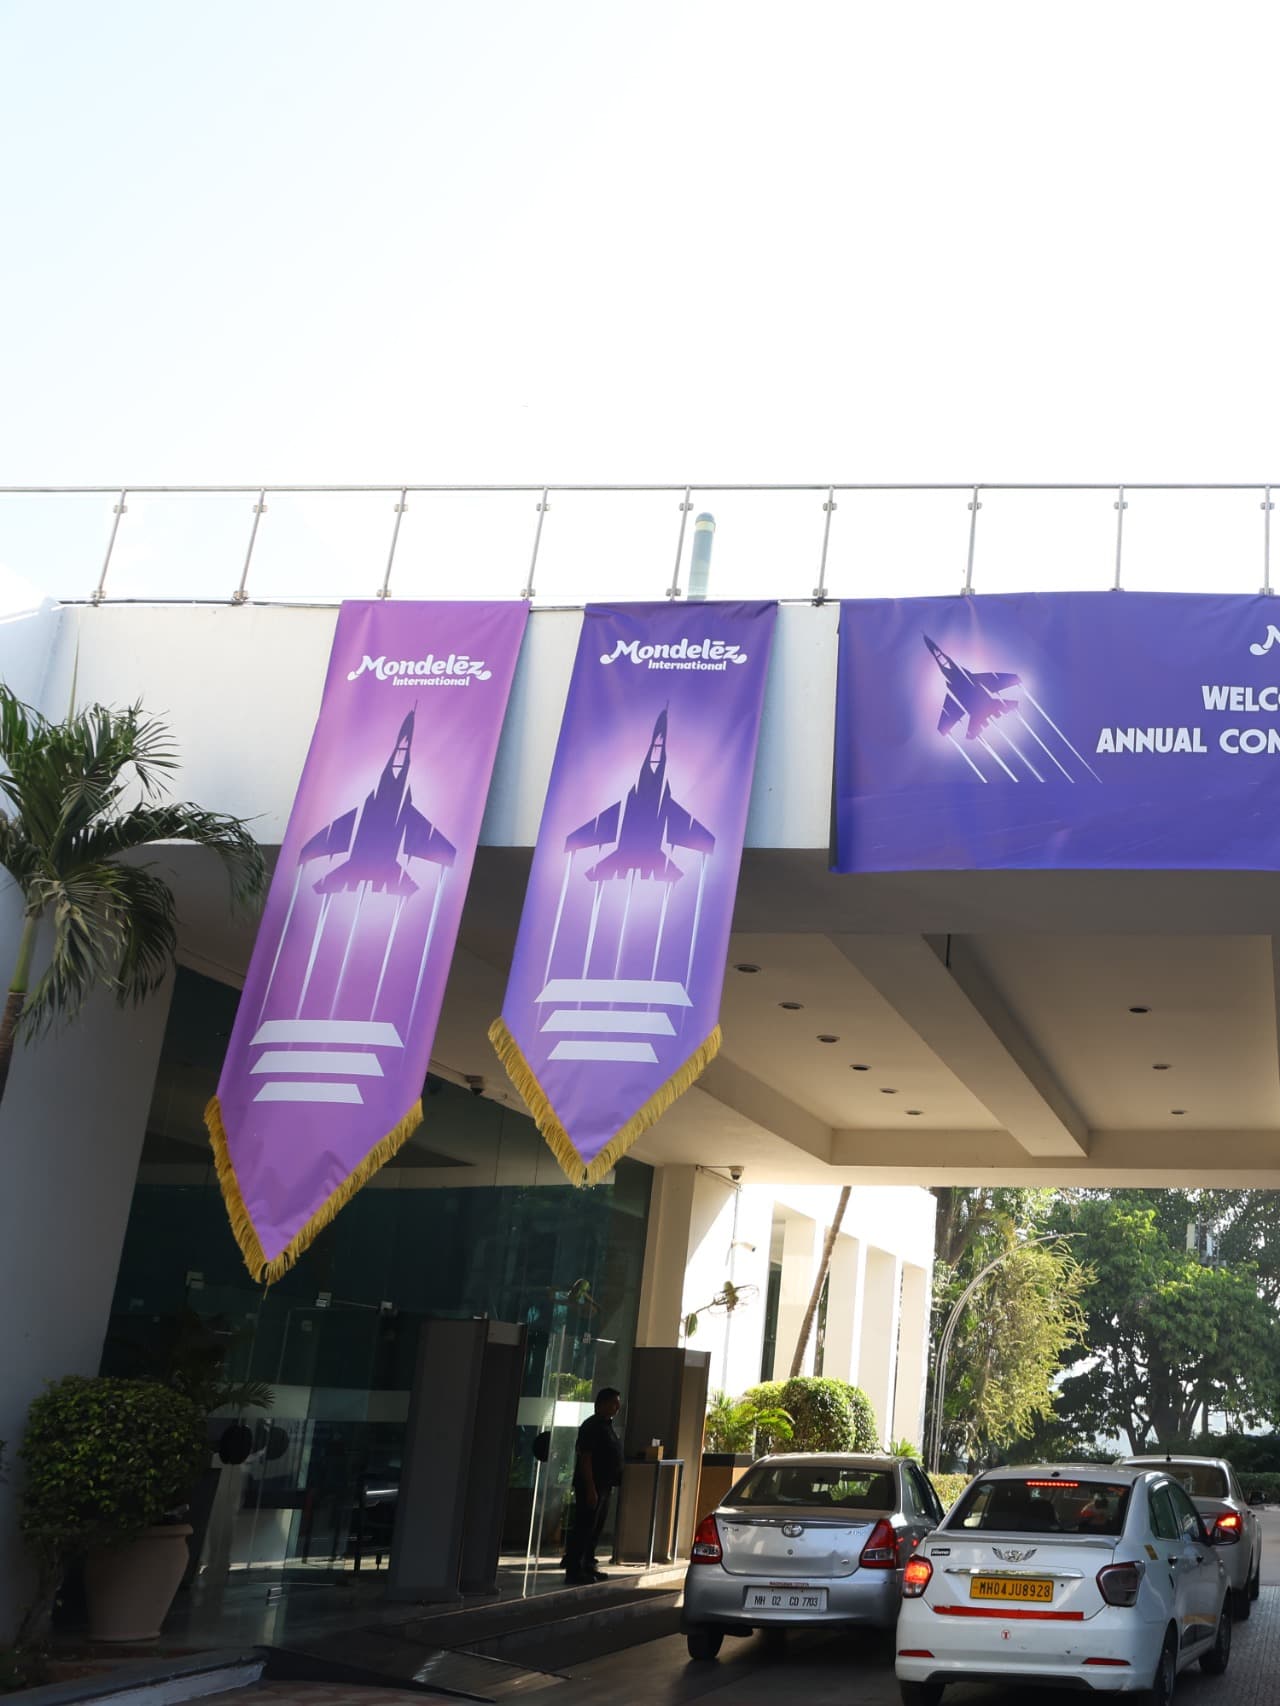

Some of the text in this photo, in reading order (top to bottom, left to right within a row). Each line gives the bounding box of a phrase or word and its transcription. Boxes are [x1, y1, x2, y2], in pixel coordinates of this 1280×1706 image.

[600, 638, 747, 665] Mondelēz
[347, 654, 492, 681] Mondelēz
[648, 659, 726, 671] International
[392, 675, 470, 686] International
[1096, 727, 1207, 754] ANNUAL
[771, 1595, 782, 1606] 02
